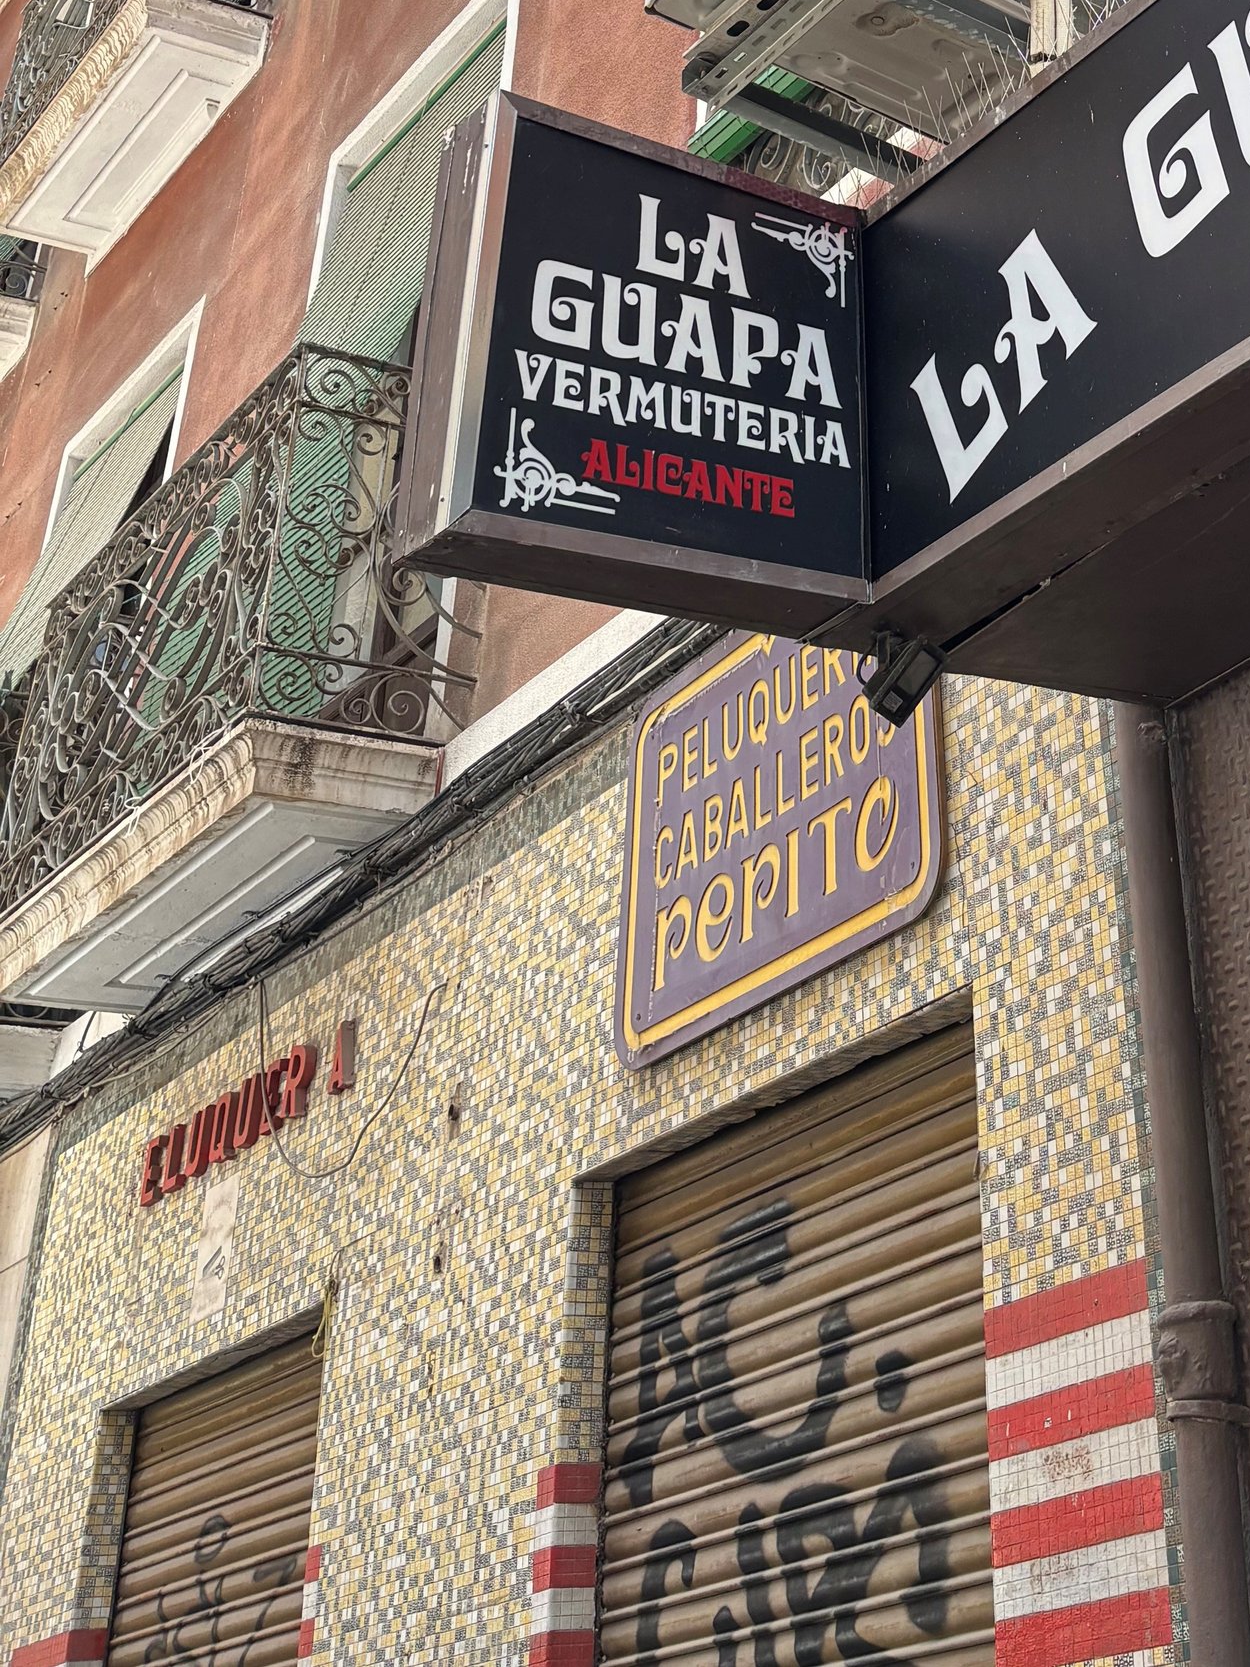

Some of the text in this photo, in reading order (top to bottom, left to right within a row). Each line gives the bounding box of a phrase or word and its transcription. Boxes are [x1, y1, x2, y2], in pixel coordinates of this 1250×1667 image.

[636, 194, 750, 299] LA
[531, 259, 843, 411] GUAPA
[910, 229, 1098, 504] LA
[514, 349, 852, 470] VERMUTERIA
[580, 439, 797, 518] ALICANTE
